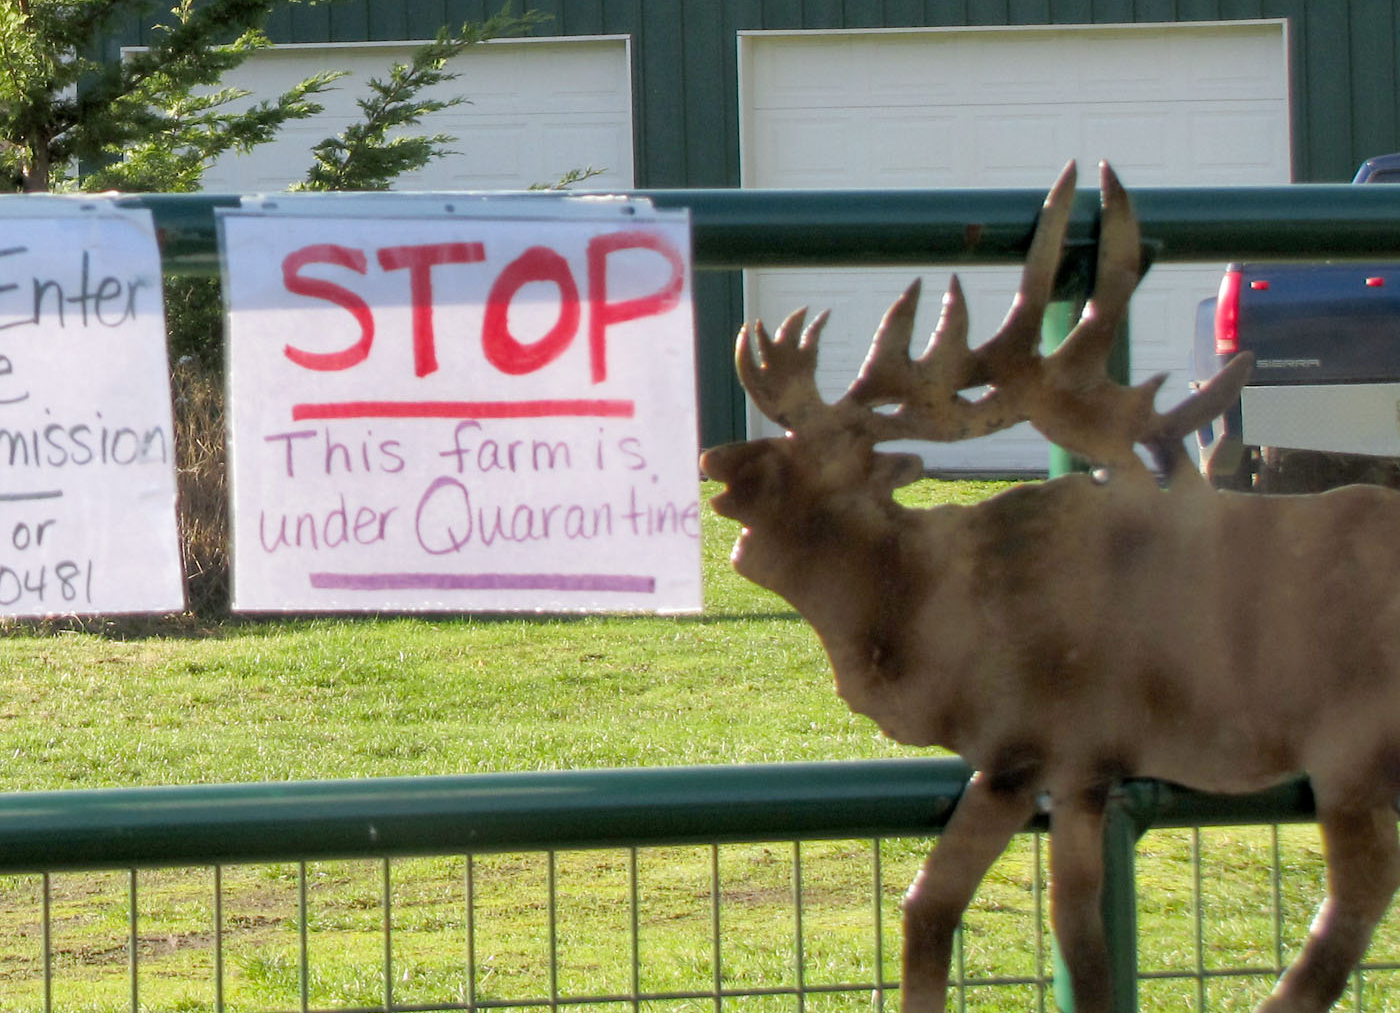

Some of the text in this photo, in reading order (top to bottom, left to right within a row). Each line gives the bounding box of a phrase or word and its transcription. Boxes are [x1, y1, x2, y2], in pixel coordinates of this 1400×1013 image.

[281, 230, 686, 385] STOP
[1255, 358, 1321, 369] SIERRA
[264, 427, 406, 477] This
[439, 420, 571, 475] farm
[13, 520, 57, 551] or
[259, 472, 700, 555] under Quarantine
